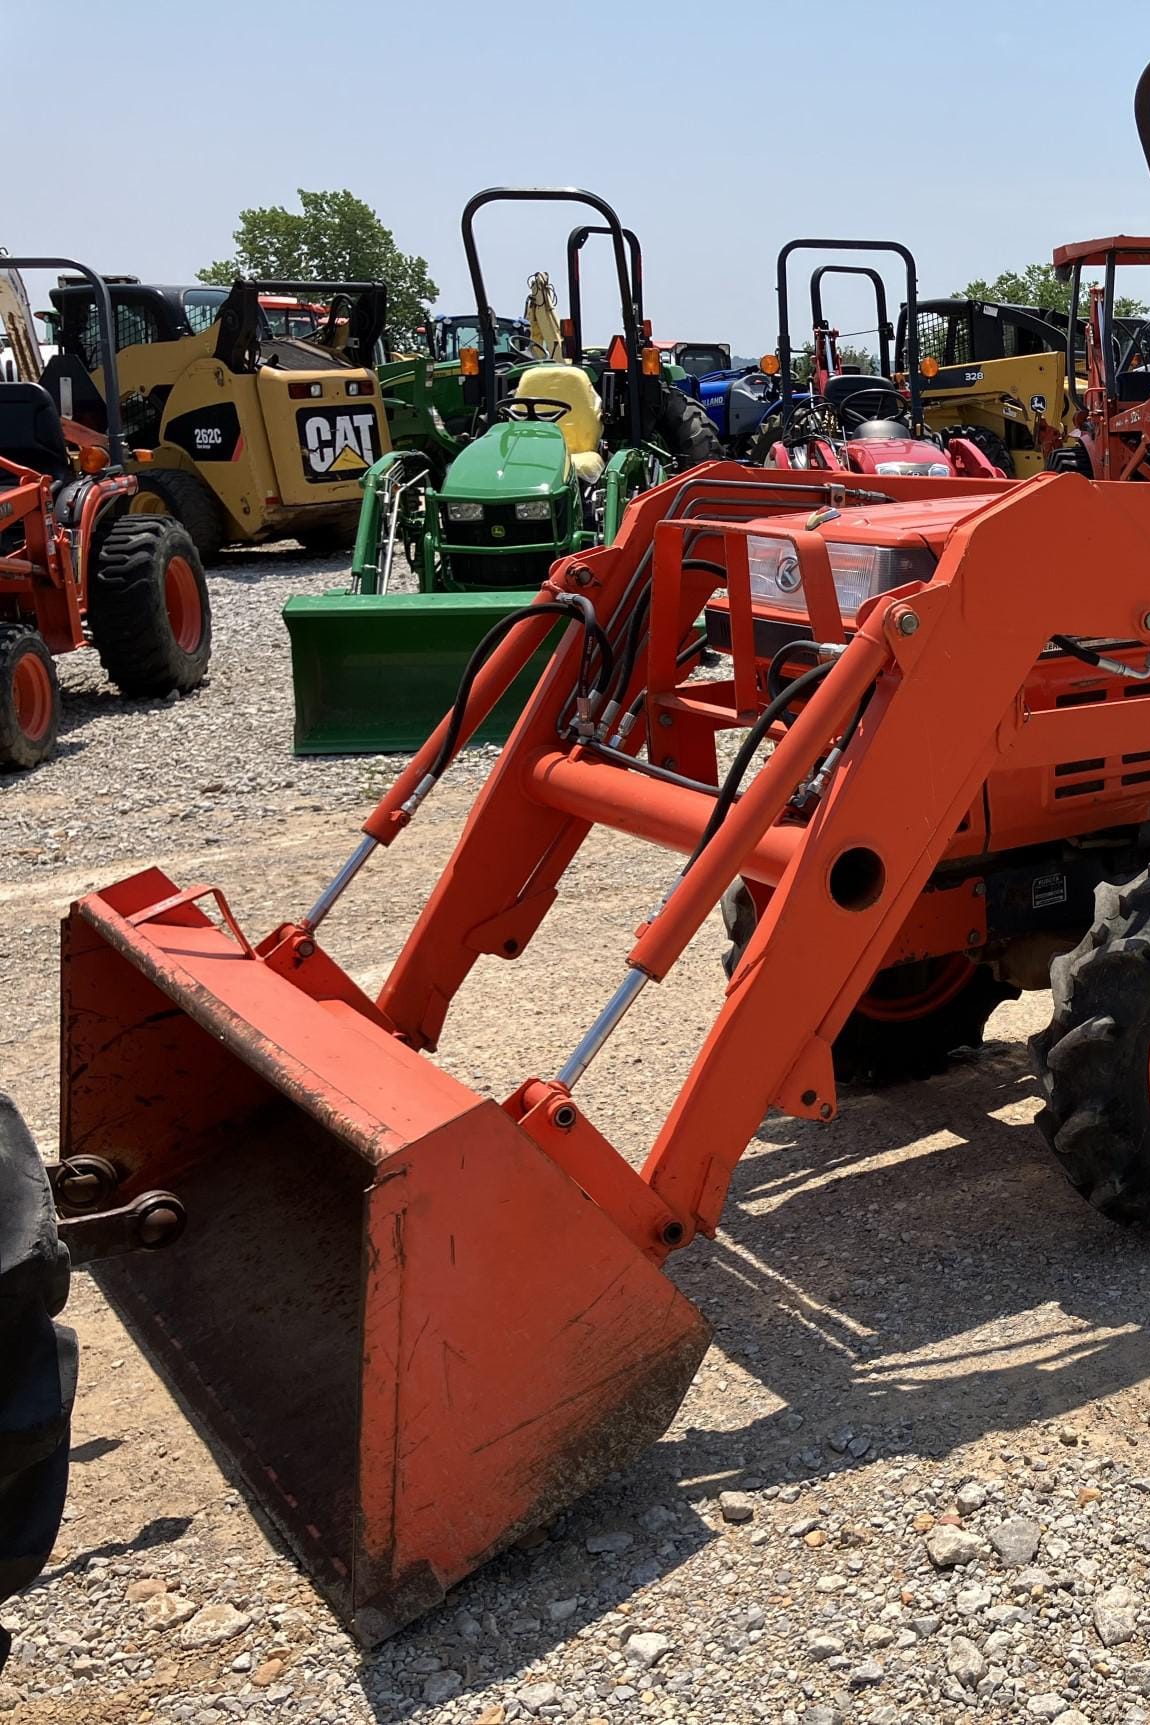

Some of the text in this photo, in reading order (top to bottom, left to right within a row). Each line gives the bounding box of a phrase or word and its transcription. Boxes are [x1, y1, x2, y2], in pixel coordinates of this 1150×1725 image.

[964, 372, 984, 381] 328
[194, 428, 222, 444] 262C
[305, 414, 375, 473] CAT
